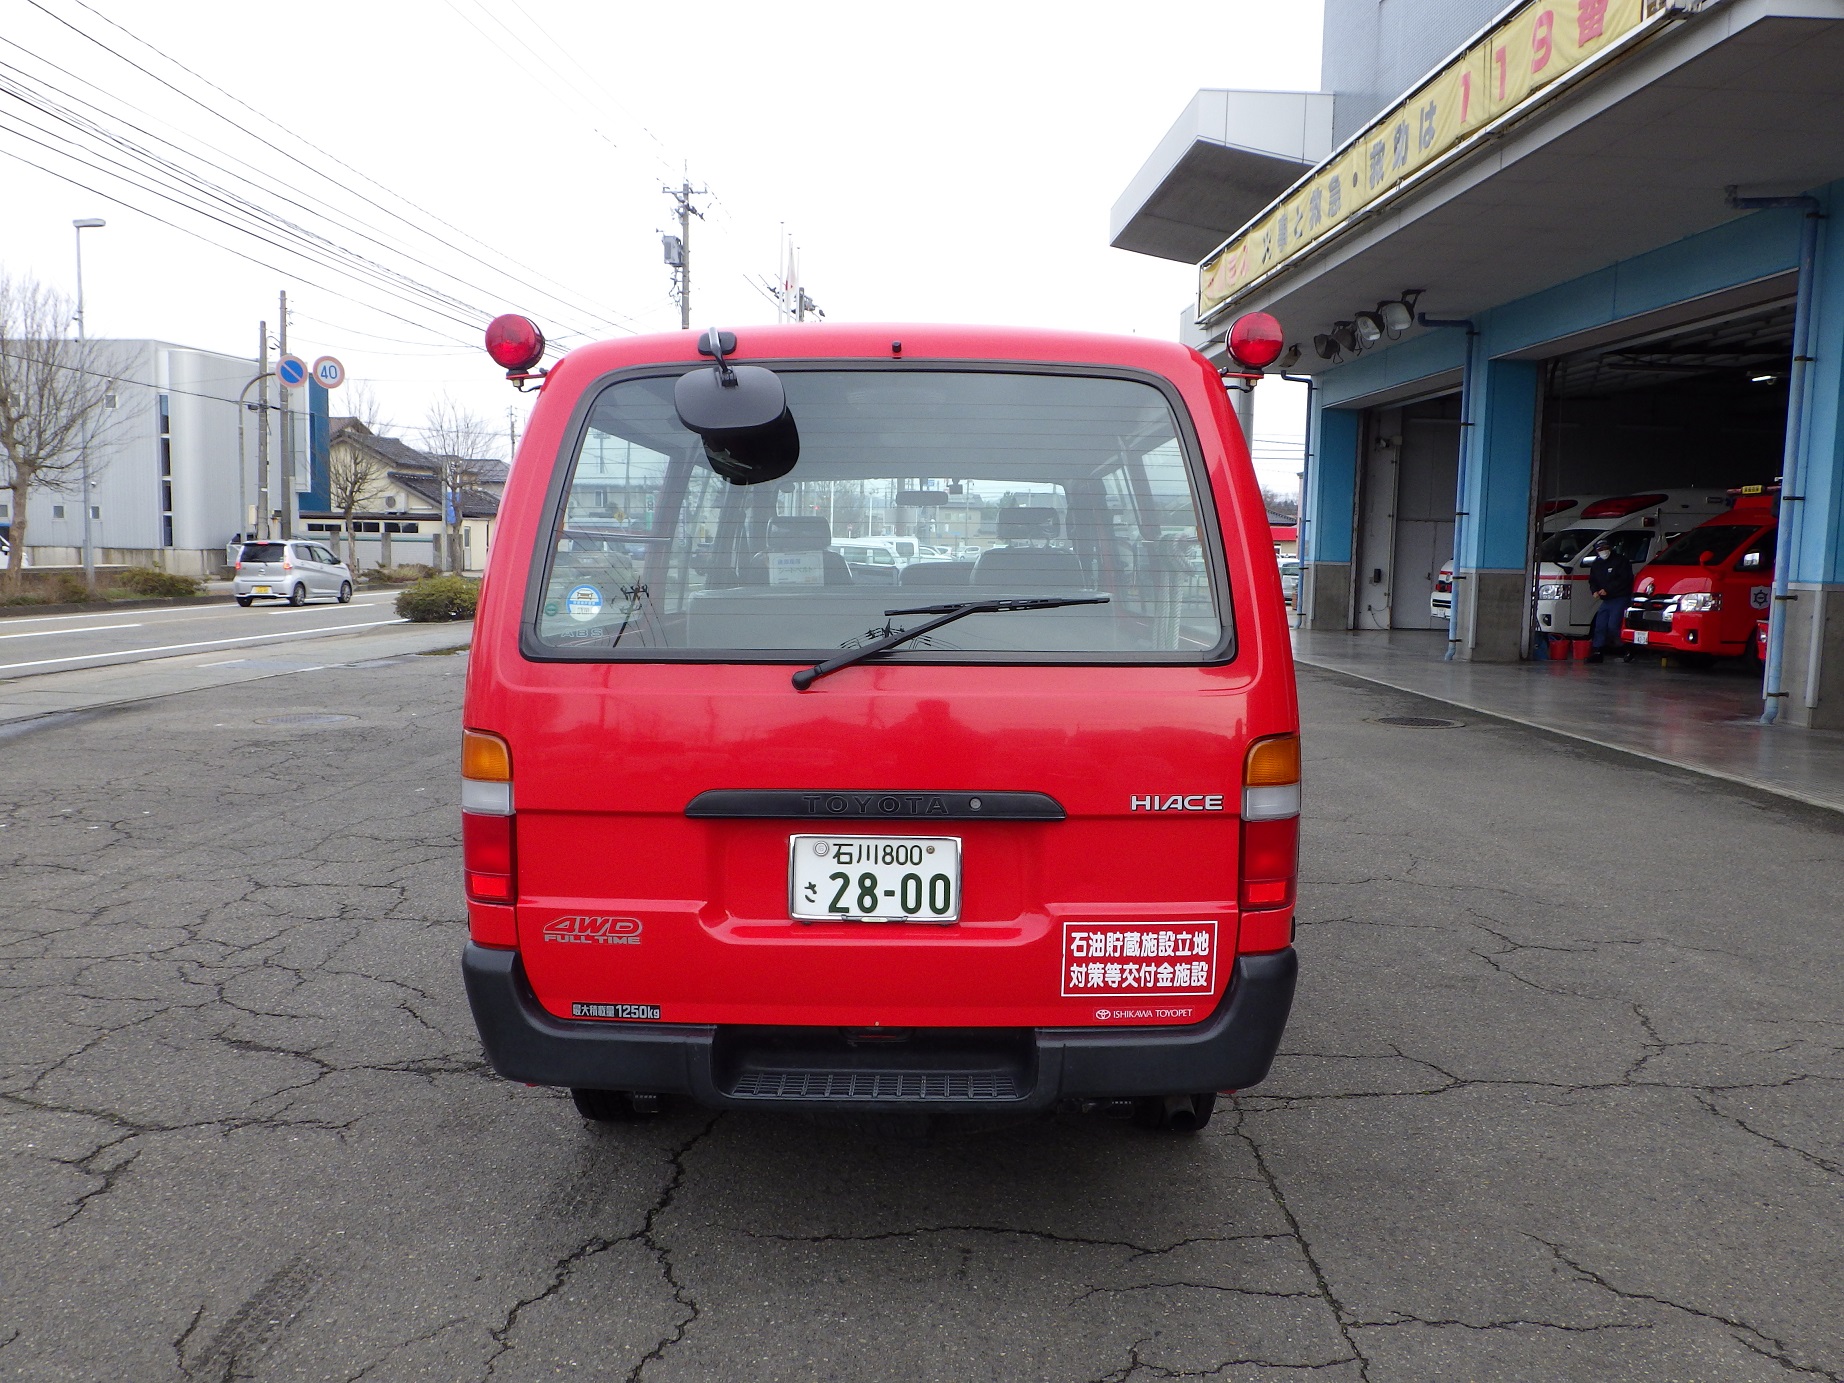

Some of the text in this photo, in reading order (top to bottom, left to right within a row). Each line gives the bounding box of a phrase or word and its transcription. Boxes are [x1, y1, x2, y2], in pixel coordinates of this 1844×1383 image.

[320, 365, 338, 379] 40
[560, 627, 604, 638] ABS
[803, 795, 949, 815] TOYOTA
[1131, 795, 1224, 811] HIACE
[828, 871, 951, 915] 28-00
[542, 915, 643, 937] 4WD
[544, 934, 641, 945] FULL TIME
[1070, 930, 1210, 958] 石油貯蔵施設立地
[1069, 961, 1210, 989] 対策等交付金施設
[1113, 1008, 1193, 1019] ISHIKAWA TOYOPET
